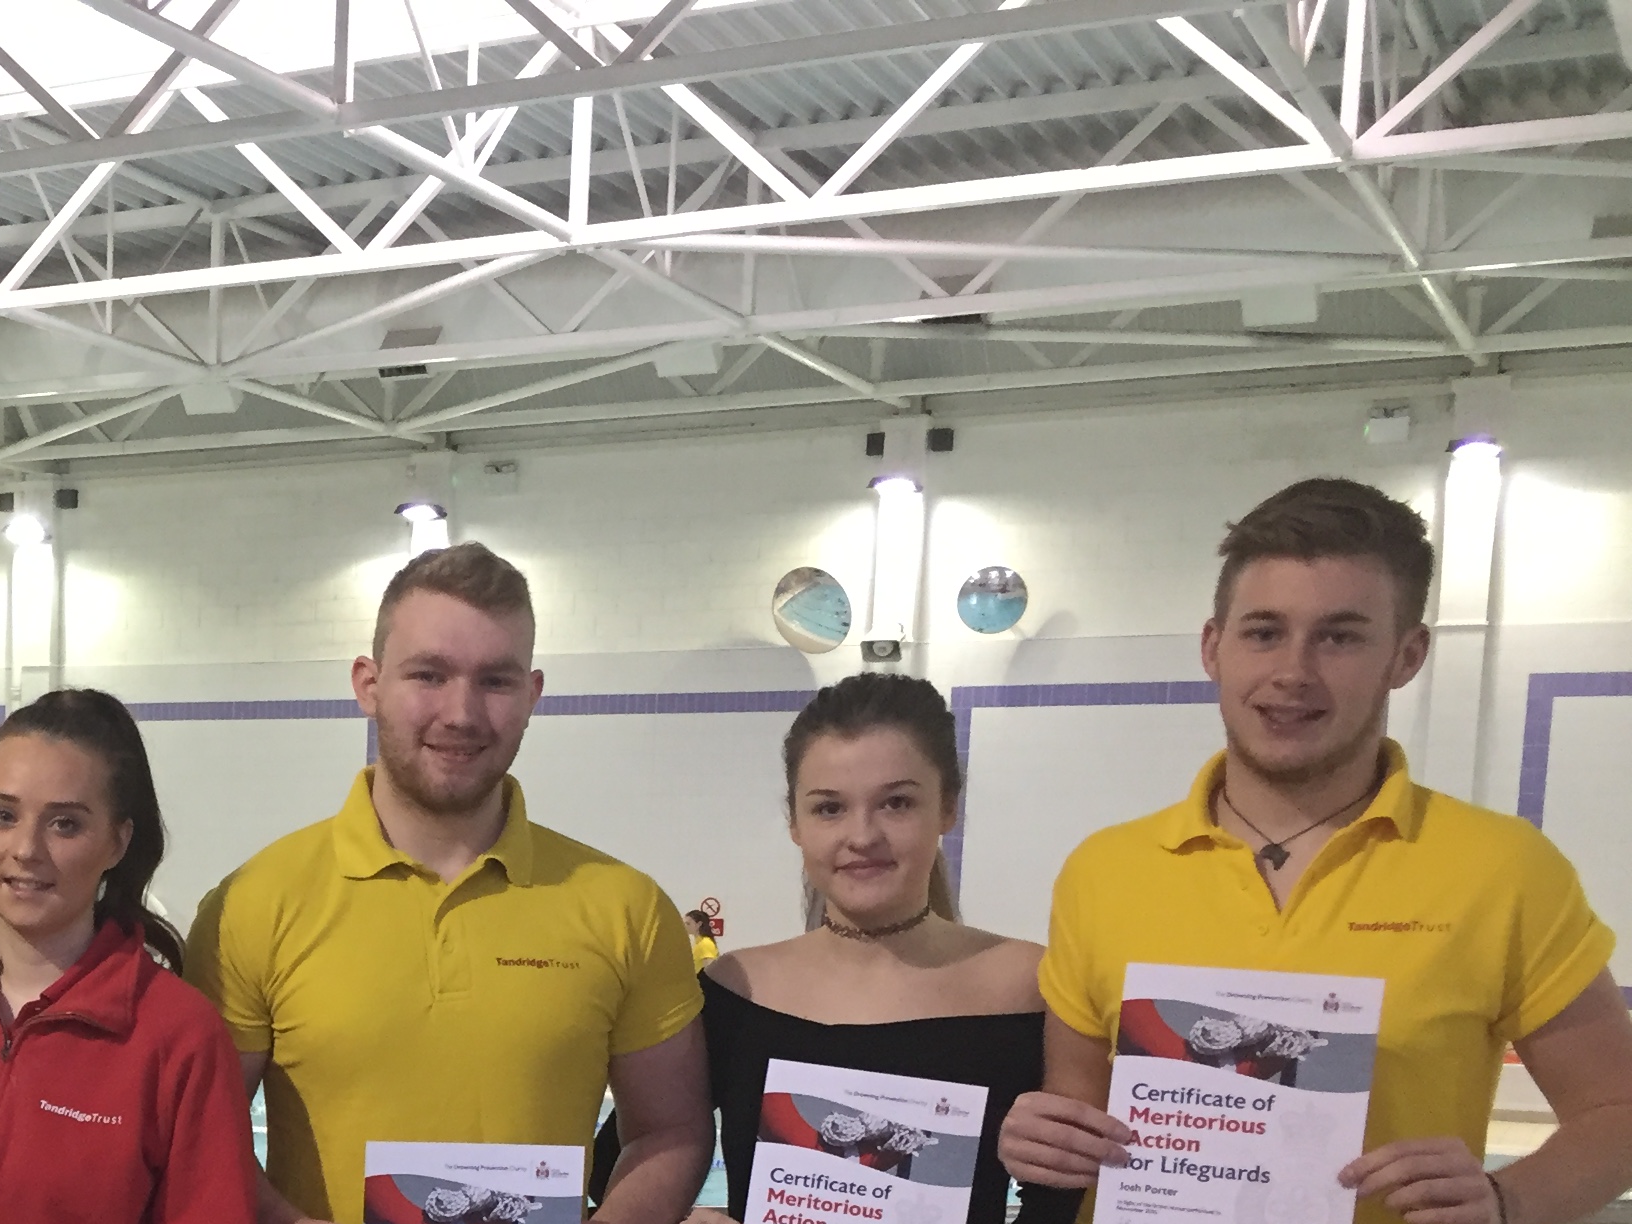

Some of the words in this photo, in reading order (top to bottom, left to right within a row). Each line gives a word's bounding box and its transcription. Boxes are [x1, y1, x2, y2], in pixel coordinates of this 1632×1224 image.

[496, 957, 580, 969] TandridgeTrust
[1131, 1083, 1246, 1110] Certificate
[1252, 1094, 1275, 1112] of
[40, 1100, 122, 1125] TandridgeTrust
[1129, 1106, 1266, 1136] Meritorious
[1127, 1130, 1201, 1152] Action
[770, 1168, 867, 1197] Certificate
[872, 1184, 893, 1200] of
[1161, 1155, 1271, 1184] Lifeguards
[1120, 1182, 1141, 1192] Josh
[1145, 1185, 1178, 1196] Porter
[767, 1188, 883, 1220] Meritorious
